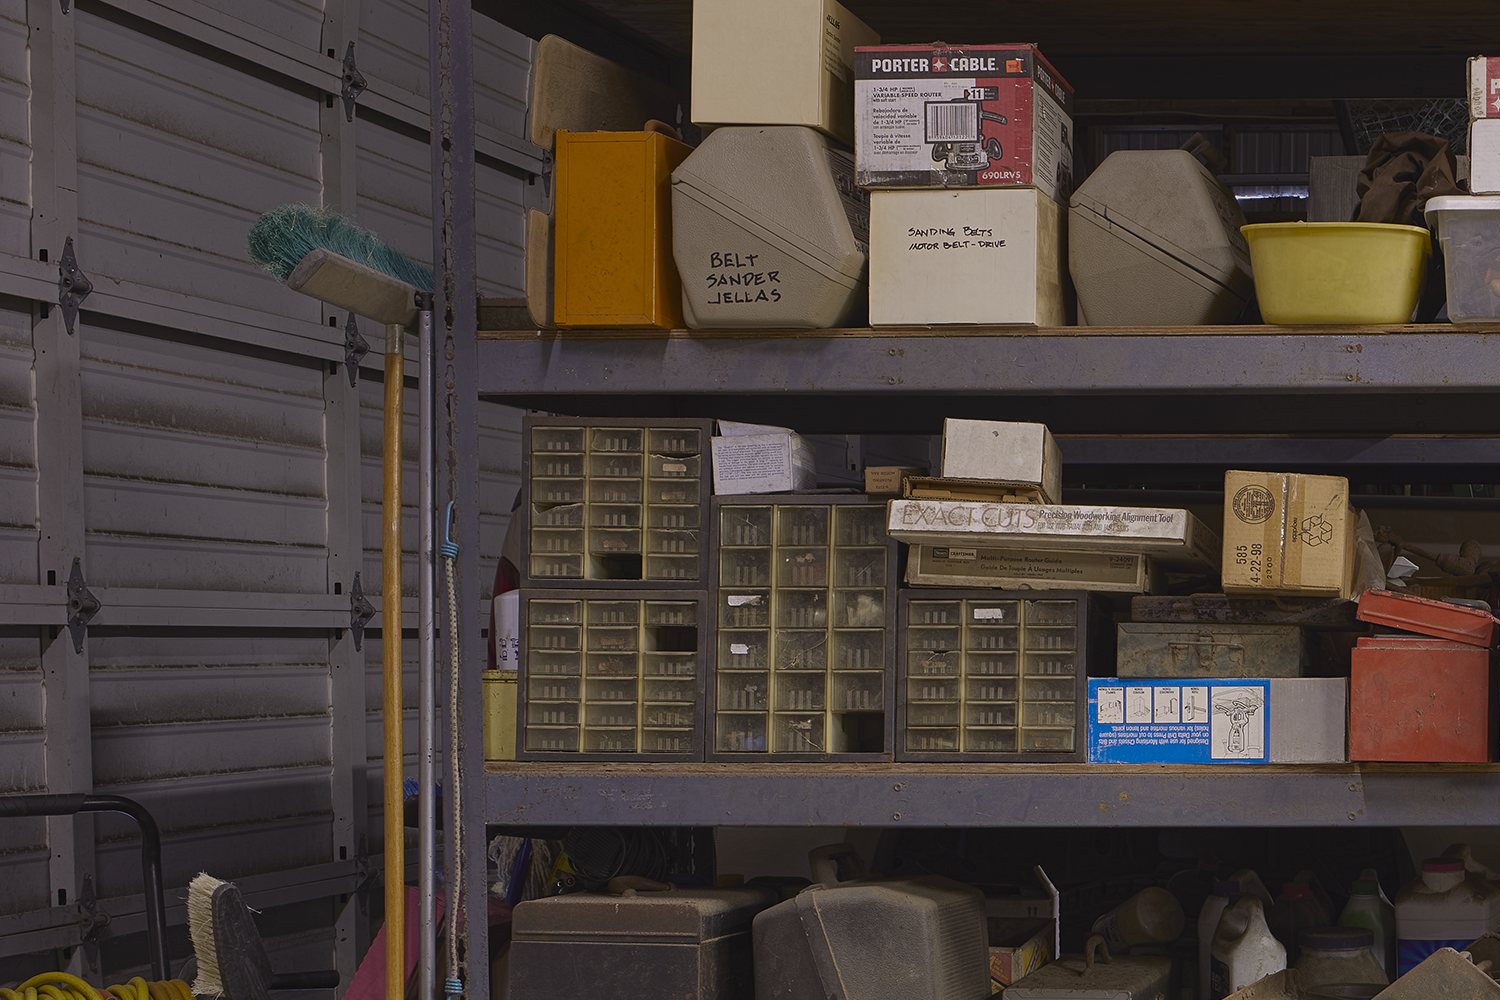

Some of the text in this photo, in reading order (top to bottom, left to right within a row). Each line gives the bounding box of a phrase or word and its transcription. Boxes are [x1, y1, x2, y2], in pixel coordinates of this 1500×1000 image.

[872, 57, 997, 73] PORTER CABLE
[972, 89, 981, 99] 11
[982, 171, 1021, 179] 690LRVS
[908, 226, 992, 237] SANDING BELTS
[710, 252, 759, 268] BELT
[706, 271, 781, 289] SANDER
[707, 288, 781, 304] JELLAS
[903, 504, 1037, 529] EXACT CUTS
[1038, 510, 1174, 523] Precision Woodworking Alignment Tool
[1236, 545, 1248, 565] 585
[1250, 543, 1262, 583] 4-22-98
[1009, 565, 1027, 573] Toupie
